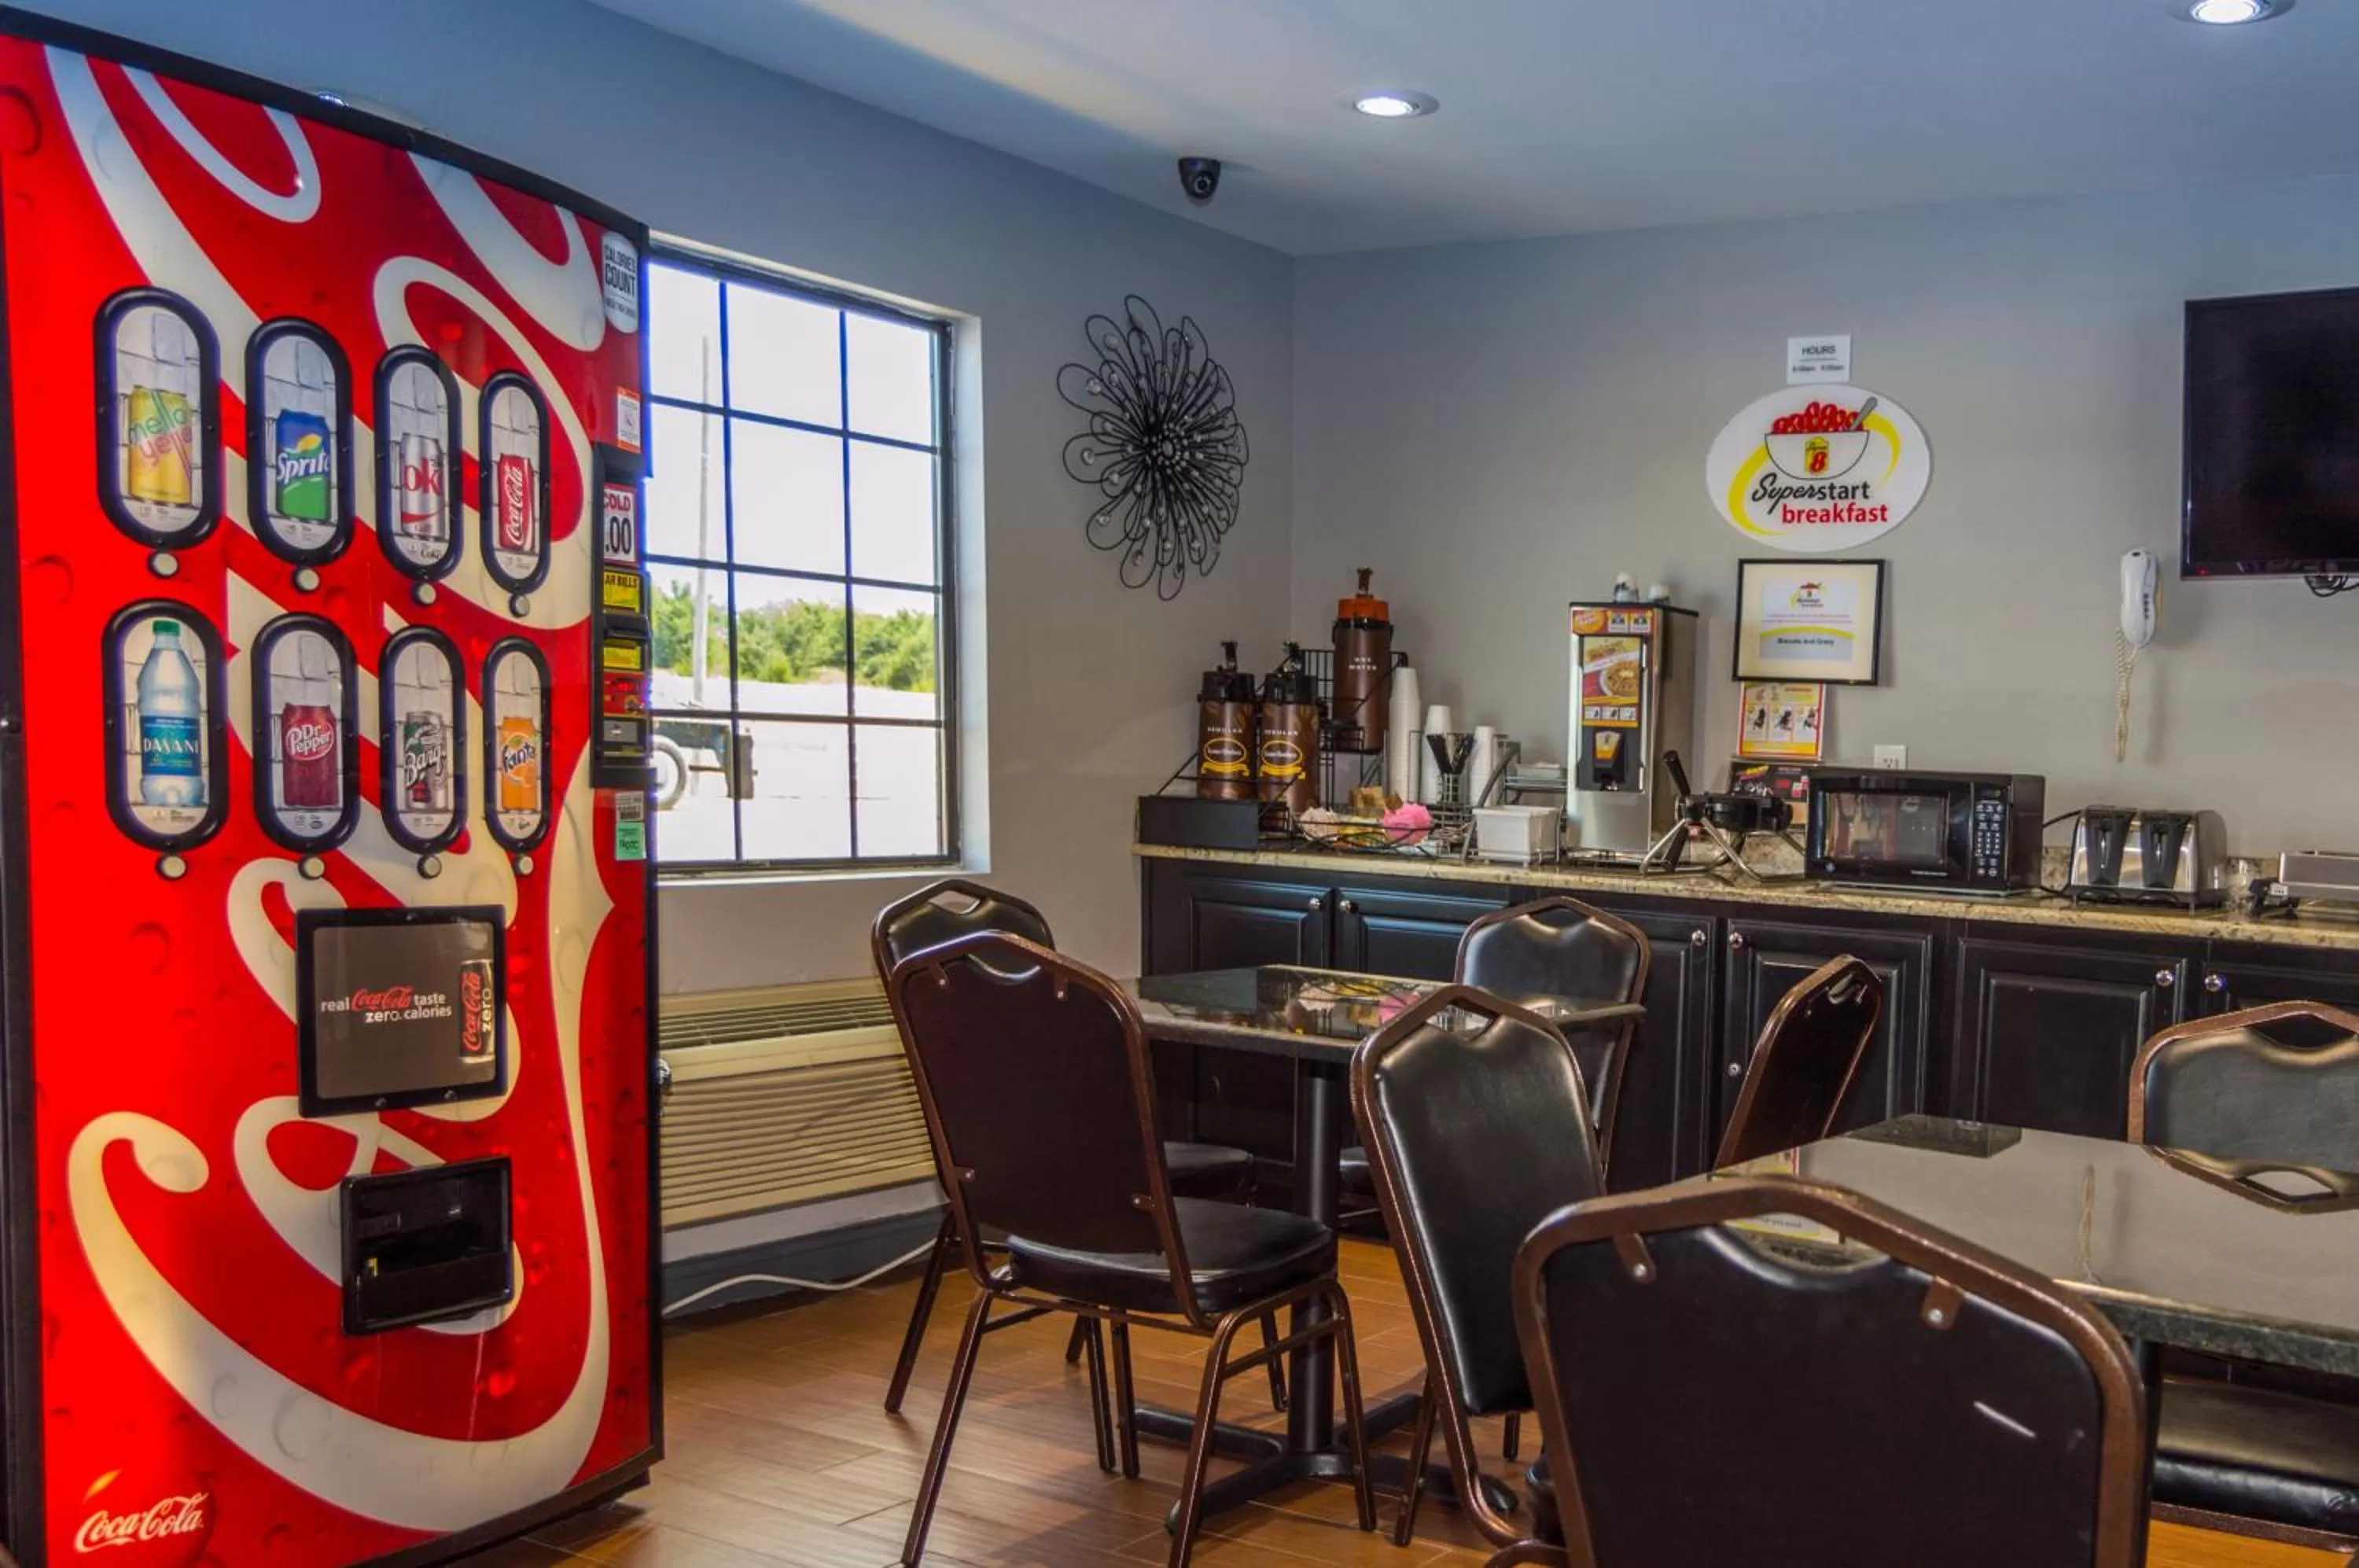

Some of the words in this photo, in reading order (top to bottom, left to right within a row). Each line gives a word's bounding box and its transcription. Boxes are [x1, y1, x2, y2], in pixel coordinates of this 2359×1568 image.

[605, 263, 636, 298] COUNT
[1801, 344, 1837, 355] HOURS
[1810, 451, 1827, 473] 8
[504, 462, 524, 546] Coca-Cola
[1752, 472, 1870, 514] Superstart
[1782, 503, 1889, 524] breakfast
[144, 736, 199, 754] DASANI
[288, 728, 331, 756] Pepper
[302, 724, 322, 739] Dr
[503, 742, 535, 772] Fanta
[321, 997, 350, 1012] real
[351, 985, 414, 1011] Coca-Cola
[414, 992, 446, 1007] taste
[404, 1005, 452, 1020] calories
[462, 971, 481, 1051] Coca-Cola
[482, 988, 492, 1032] zero
[75, 1493, 209, 1554] Coca-Cola
